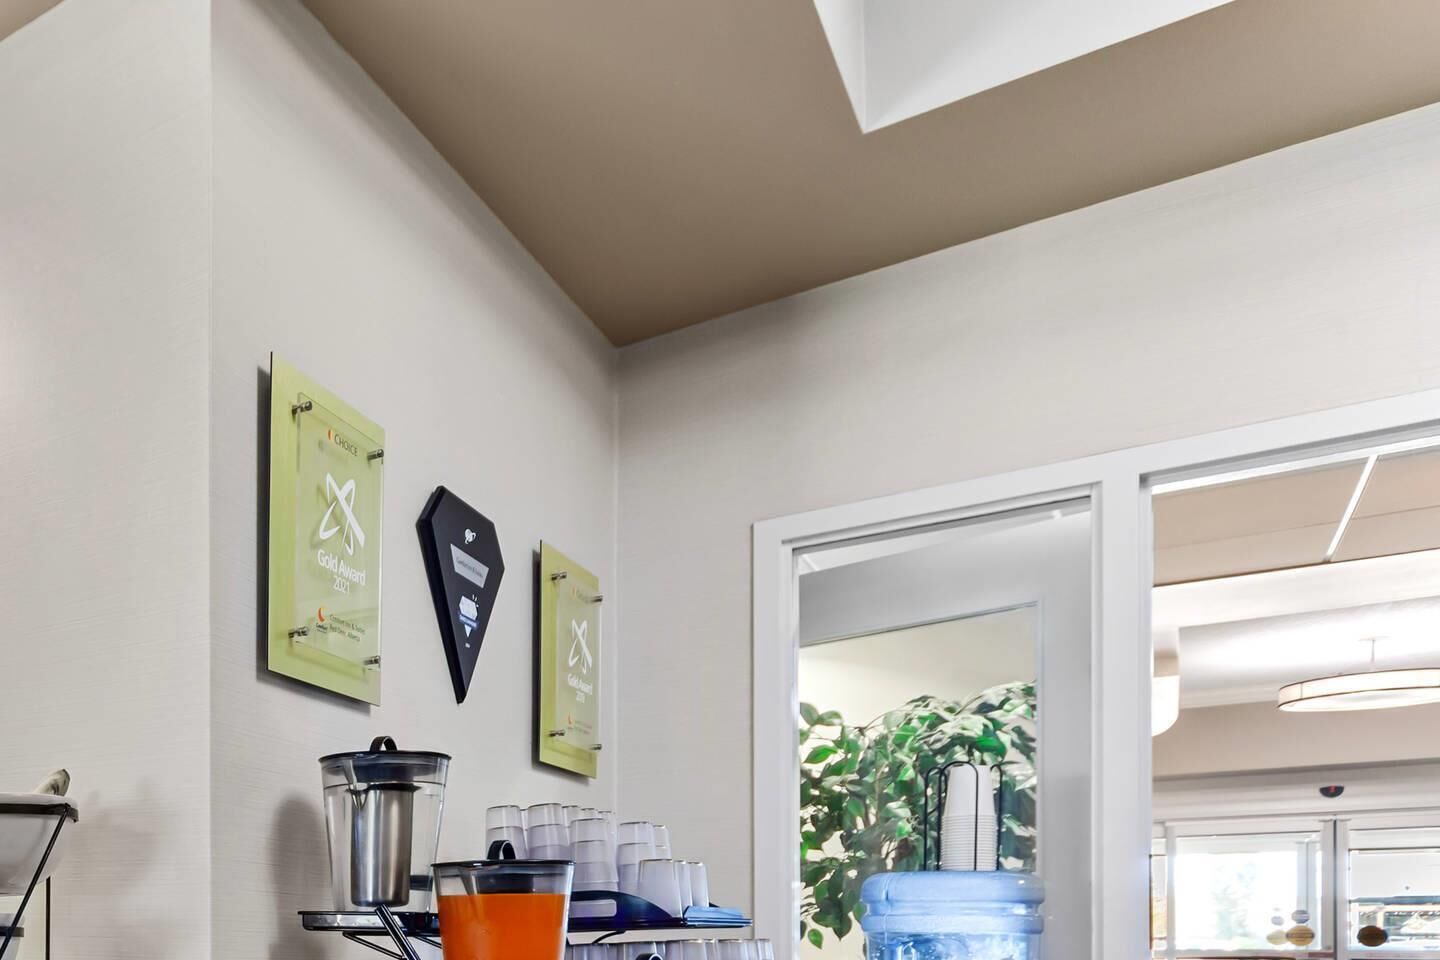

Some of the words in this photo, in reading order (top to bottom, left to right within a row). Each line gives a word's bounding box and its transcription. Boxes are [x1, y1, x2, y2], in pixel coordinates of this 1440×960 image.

[334, 433, 358, 456] CHOICE
[317, 548, 338, 573] Gold
[338, 559, 366, 586] Award
